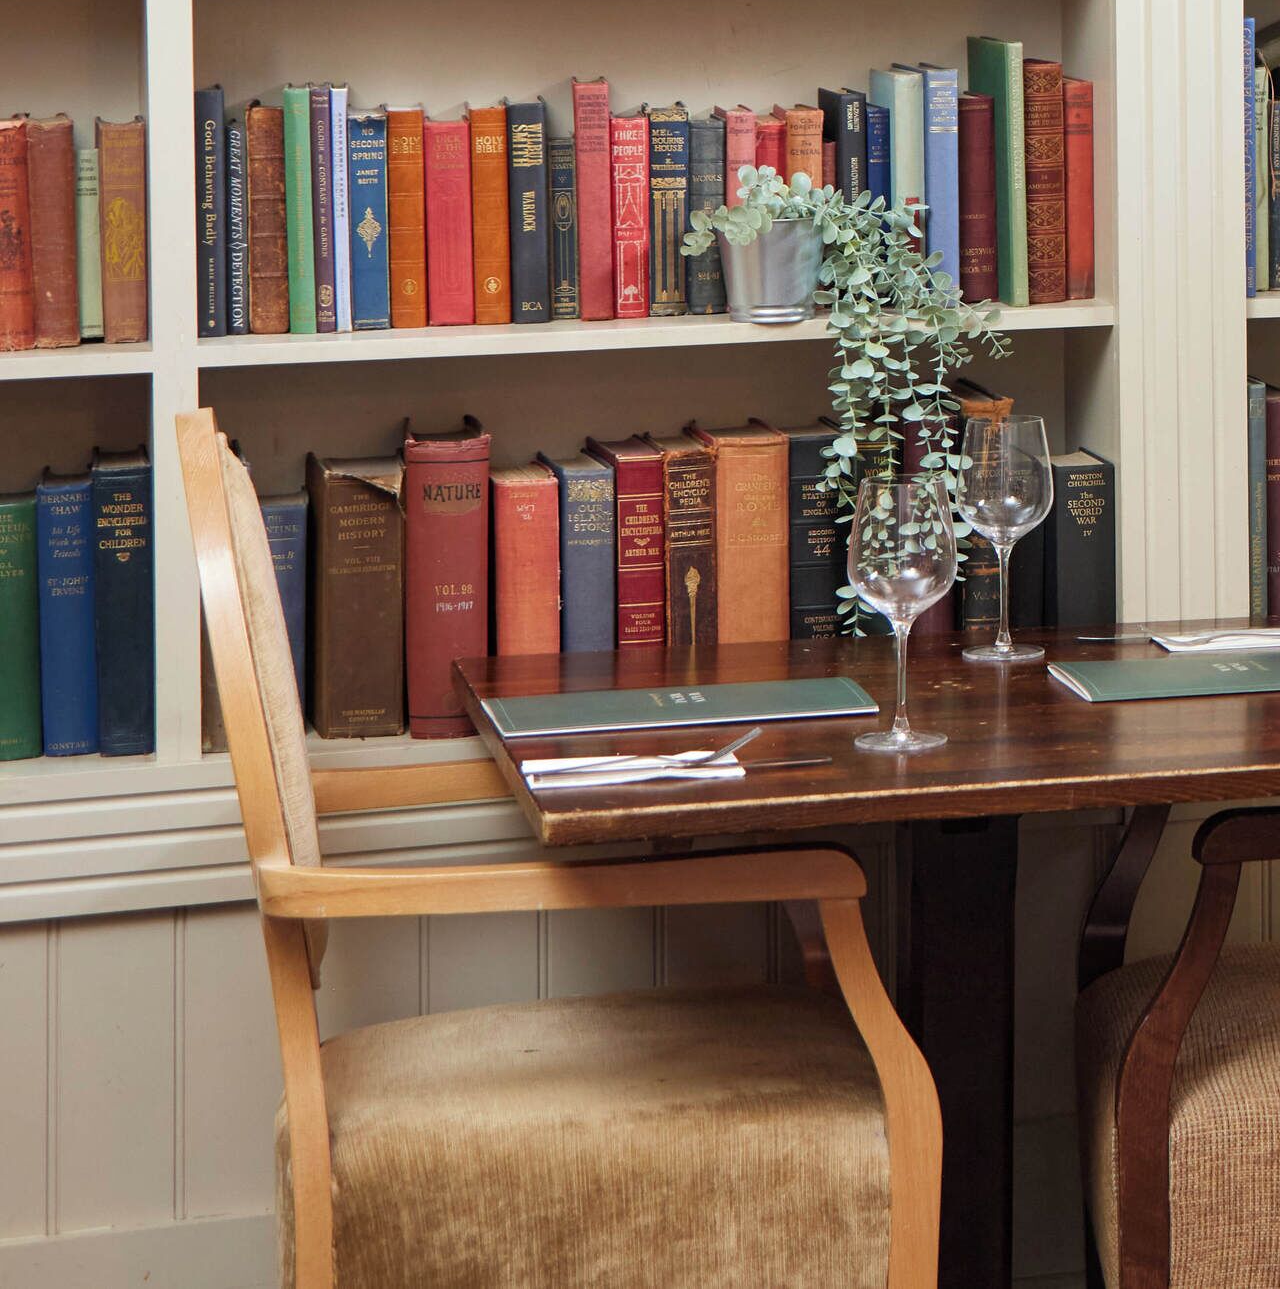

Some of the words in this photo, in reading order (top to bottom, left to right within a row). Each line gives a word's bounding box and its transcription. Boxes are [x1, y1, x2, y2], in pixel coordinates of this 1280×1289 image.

[204, 120, 216, 152] Gods
[361, 127, 374, 136] NO
[614, 130, 643, 140] THREE
[351, 140, 384, 148] SECOND
[476, 136, 504, 145] HOLY
[527, 122, 543, 168] WILBUR
[652, 137, 685, 145] BOURNE
[230, 128, 242, 174] GREAT
[476, 144, 504, 153] BIBLE
[511, 124, 528, 168] SMITH
[613, 145, 643, 156] PEOPLE
[352, 152, 383, 160] SPRING
[202, 154, 217, 210] Behaving
[692, 173, 723, 183] WORKS
[230, 176, 243, 242] MOMENTS
[522, 190, 536, 232] WARLOCK
[202, 213, 217, 246] Badly
[231, 252, 245, 328] DETECTION
[521, 302, 543, 310] BCA
[682, 473, 696, 481] THE
[669, 480, 711, 490] CHILDREN'S
[113, 493, 132, 501] THE
[423, 483, 481, 503] NATURE
[673, 489, 710, 498] ENCYCLO-
[679, 497, 701, 505] PEDIA
[1067, 500, 1104, 509] SECOND
[51, 505, 82, 515] SHAW
[102, 503, 144, 513] WONDER
[737, 501, 781, 512] ROME
[1071, 508, 1102, 516] WORLD
[339, 516, 385, 527] MODERN
[1076, 517, 1097, 526] WAR
[338, 529, 386, 541] HISTORY
[670, 530, 695, 538] ARTHUR
[99, 538, 146, 549] CHILDREN
[624, 549, 648, 557] ARTHUR
[814, 546, 832, 557] 44
